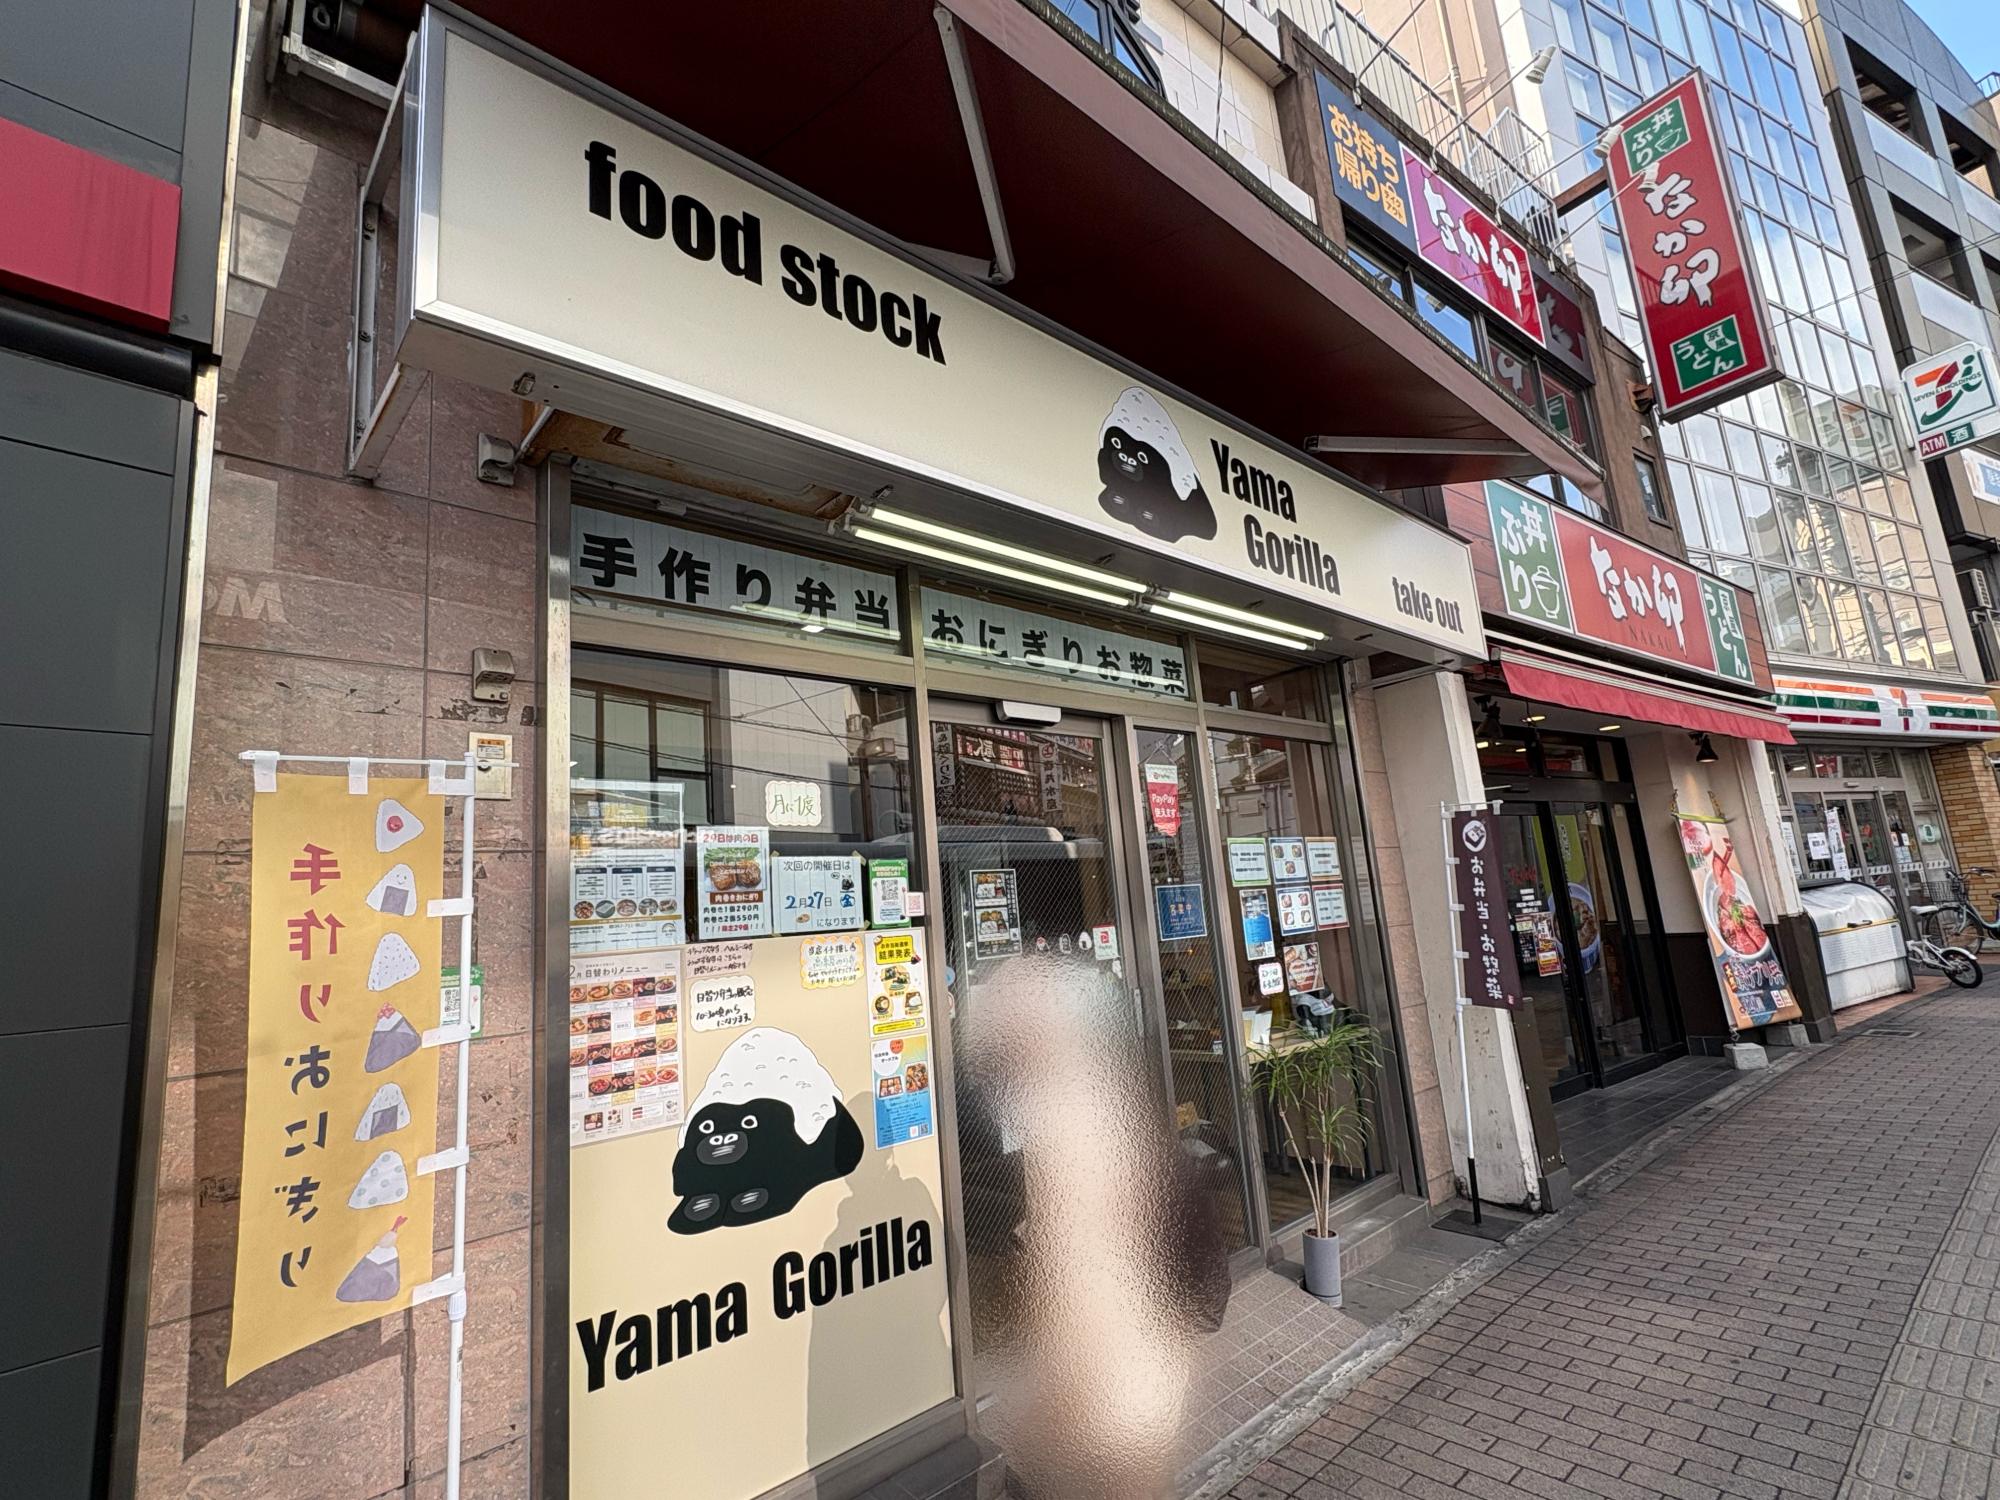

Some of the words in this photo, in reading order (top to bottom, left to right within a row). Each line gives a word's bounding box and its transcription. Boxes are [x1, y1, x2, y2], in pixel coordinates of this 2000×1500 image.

[1328, 104, 1399, 183] お持ち
[1334, 141, 1380, 202] 帰り
[585, 140, 763, 285] food
[780, 243, 947, 366] stock
[1424, 178, 1523, 319] なか卯
[1644, 173, 1721, 308] なか卯
[1676, 341, 1734, 375] うどん
[1945, 371, 1981, 391] HOLDINGS
[1922, 435, 1945, 455] ATM
[1952, 426, 1969, 443] 酒
[1210, 438, 1297, 523] Yama
[580, 533, 889, 631] 手作り弁当
[1243, 514, 1341, 596] Gorilla
[1500, 500, 1547, 609] 丼ぶり
[1392, 577, 1433, 629] take
[1435, 596, 1464, 634] out
[1589, 535, 1687, 658] なか卯
[1703, 583, 1747, 678] うどん
[1629, 625, 1672, 652] NAKAU
[1152, 793, 1176, 805] PayPay
[784, 860, 850, 871] 次回の開催日は
[586, 966, 648, 978] 日替わりメニュー
[575, 1281, 748, 1393] Yama
[773, 1216, 933, 1320] Gorilla
